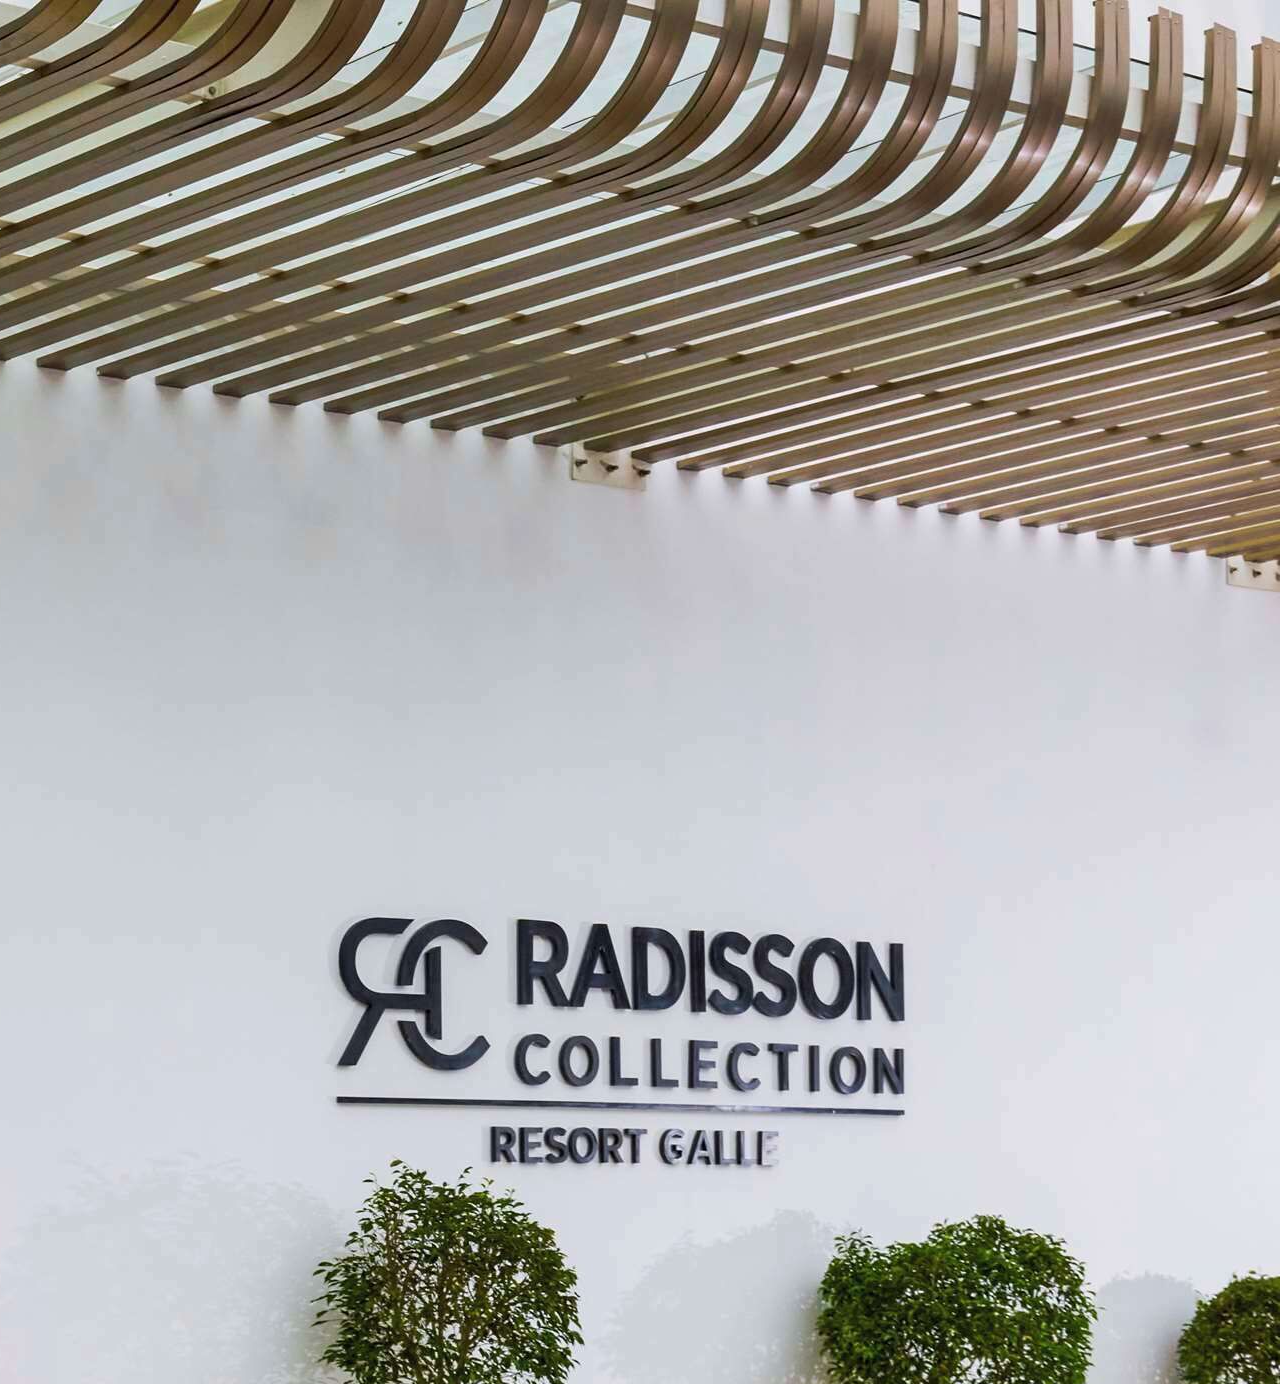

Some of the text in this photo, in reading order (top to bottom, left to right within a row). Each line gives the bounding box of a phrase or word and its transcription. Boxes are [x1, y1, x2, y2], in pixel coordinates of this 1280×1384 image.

[516, 917, 905, 1022] RADISSON
[514, 1033, 905, 1094] COLLECTION
[490, 1125, 780, 1166] RESORT GALLE
